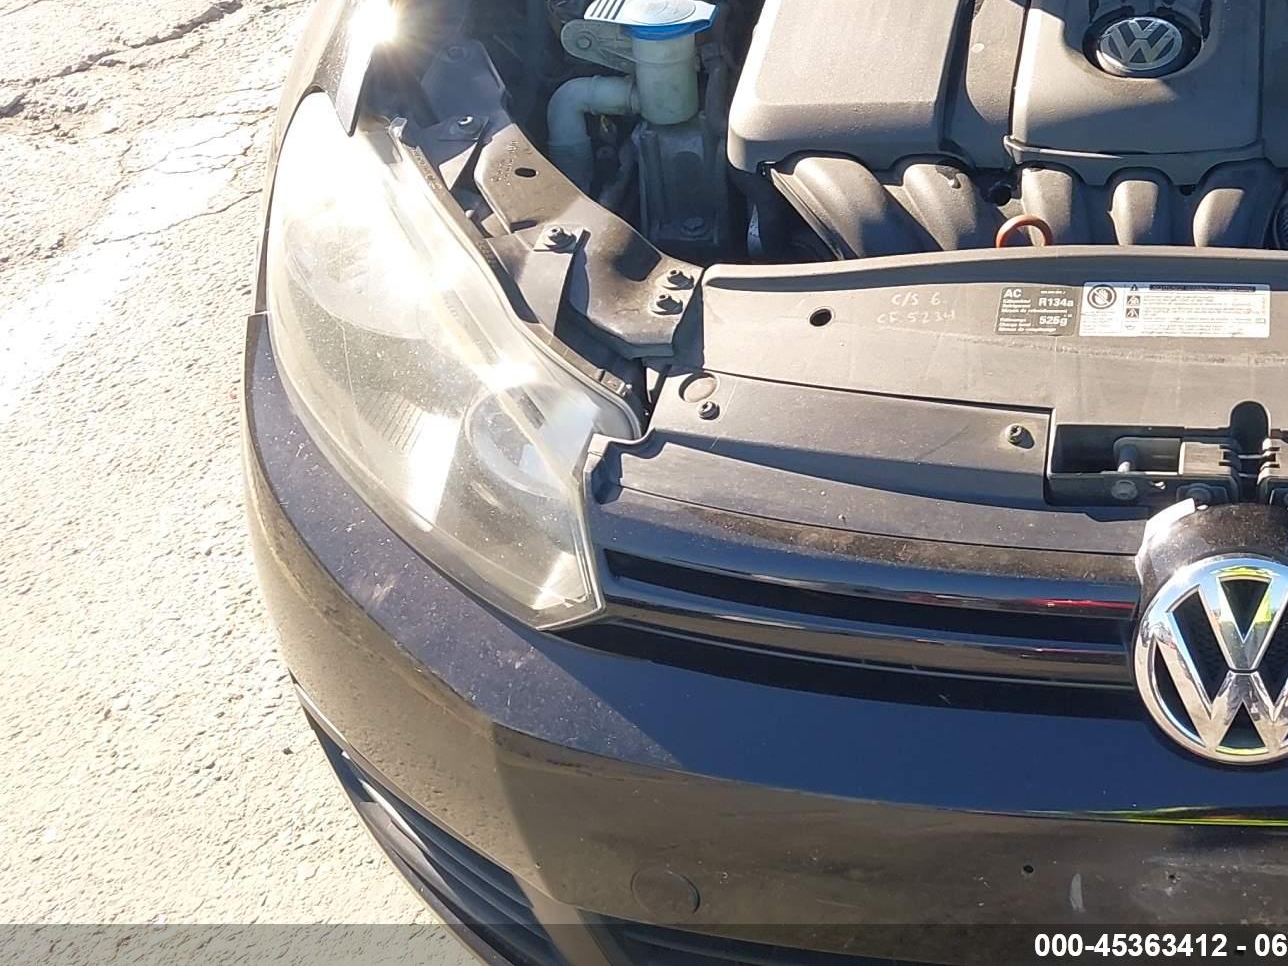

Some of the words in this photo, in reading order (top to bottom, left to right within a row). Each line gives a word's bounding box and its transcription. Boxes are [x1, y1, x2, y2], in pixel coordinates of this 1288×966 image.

[1100, 15, 1183, 71] VW
[1003, 288, 1022, 298] AC
[1038, 297, 1074, 307] R134a
